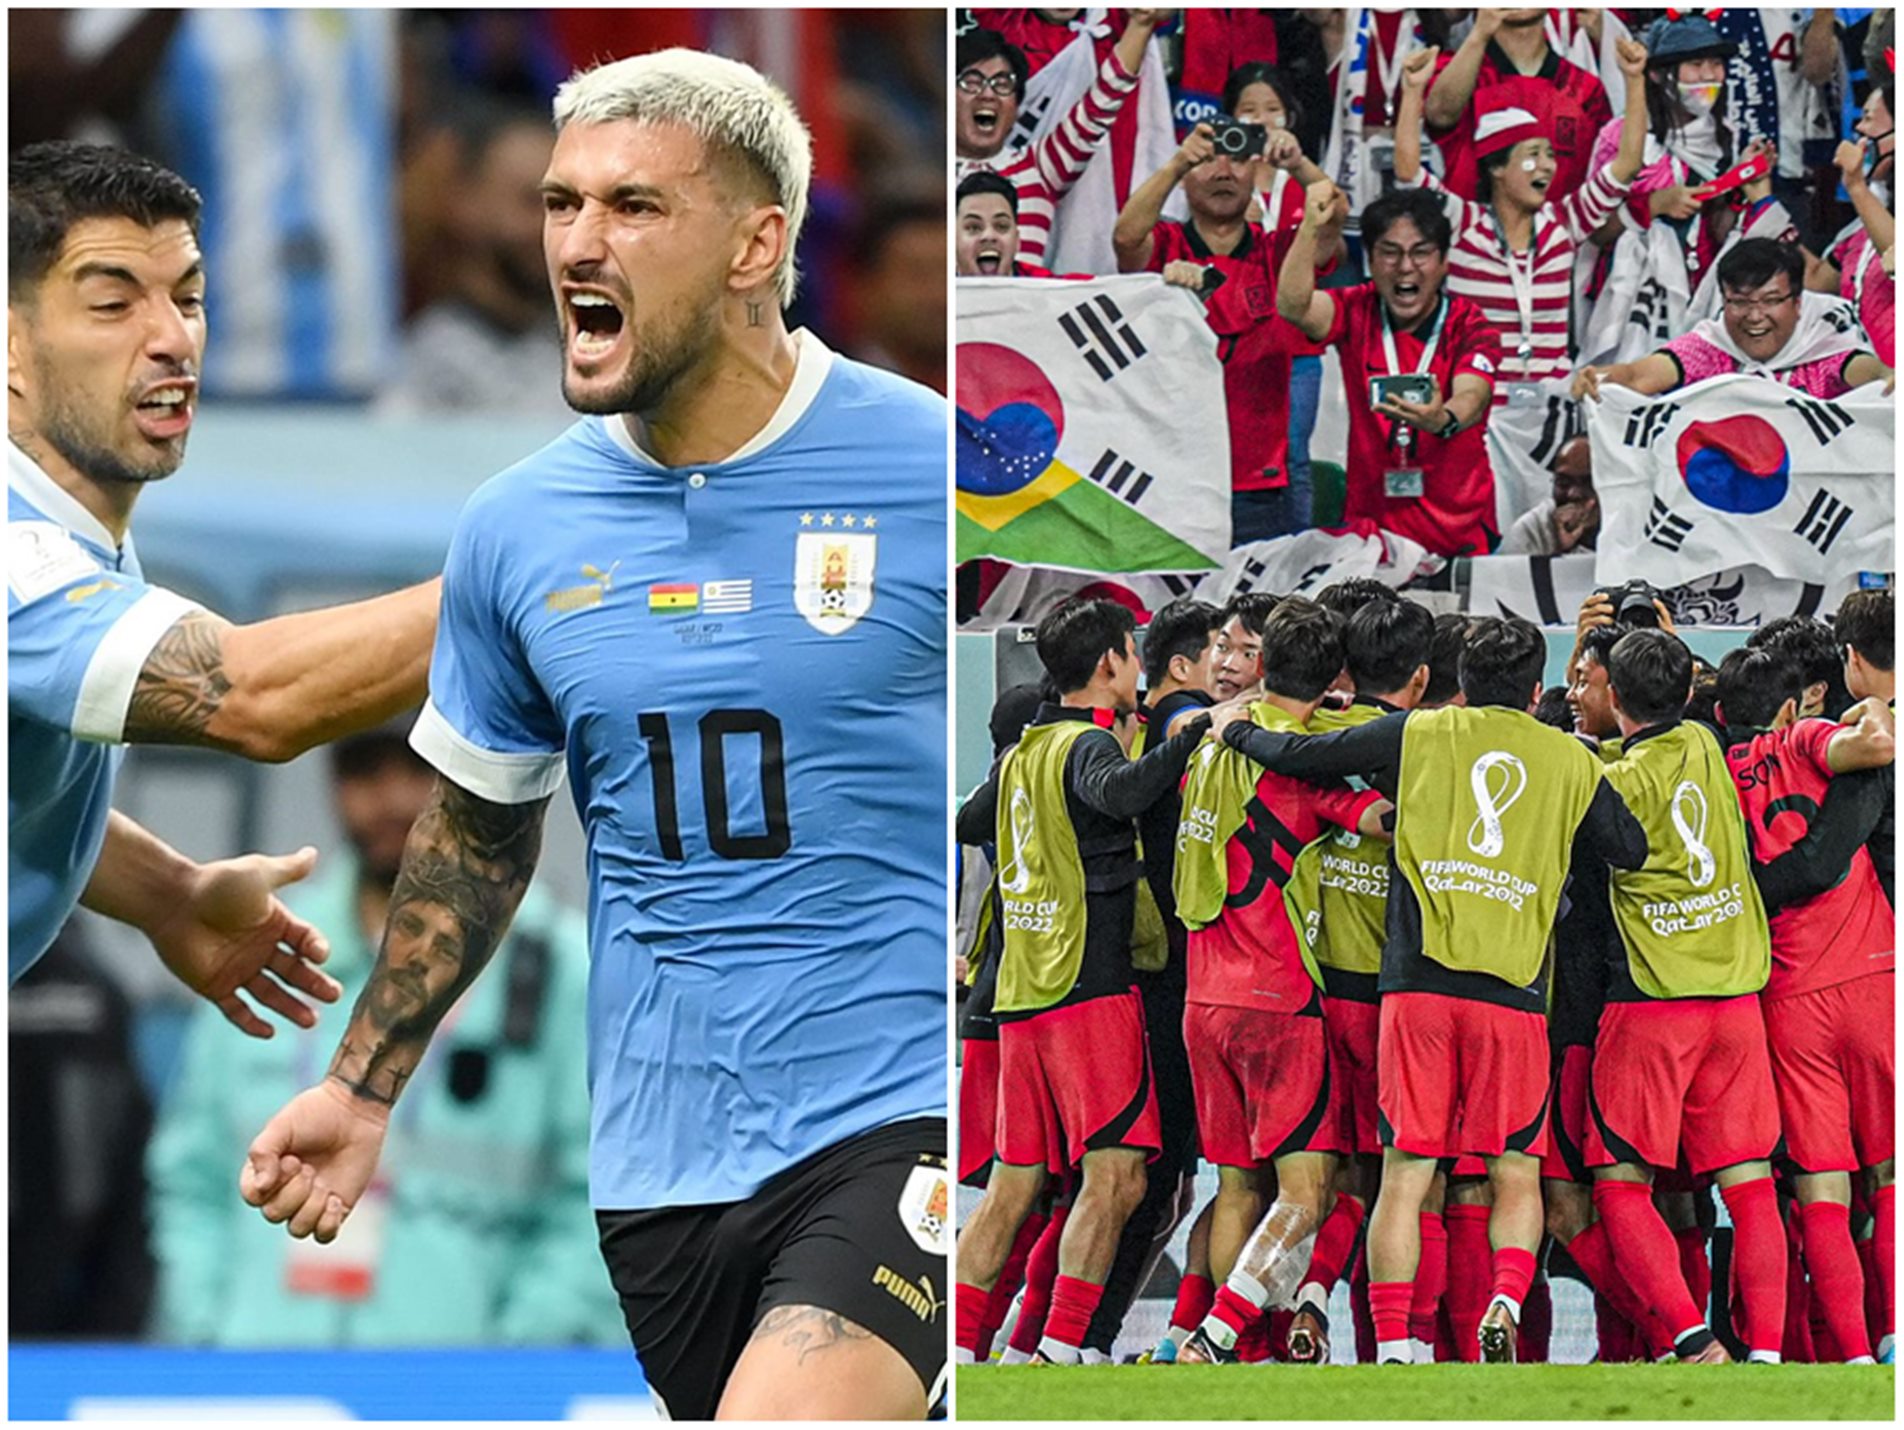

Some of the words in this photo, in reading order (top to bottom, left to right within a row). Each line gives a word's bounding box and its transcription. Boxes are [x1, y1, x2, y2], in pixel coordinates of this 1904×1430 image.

[637, 709, 792, 861] 10
[1323, 854, 1370, 877] WORLD
[1451, 860, 1510, 885] WORLD
[1643, 903, 1680, 919] FIFA
[1680, 888, 1731, 915] WORLD
[872, 1264, 931, 1322] PUMA
